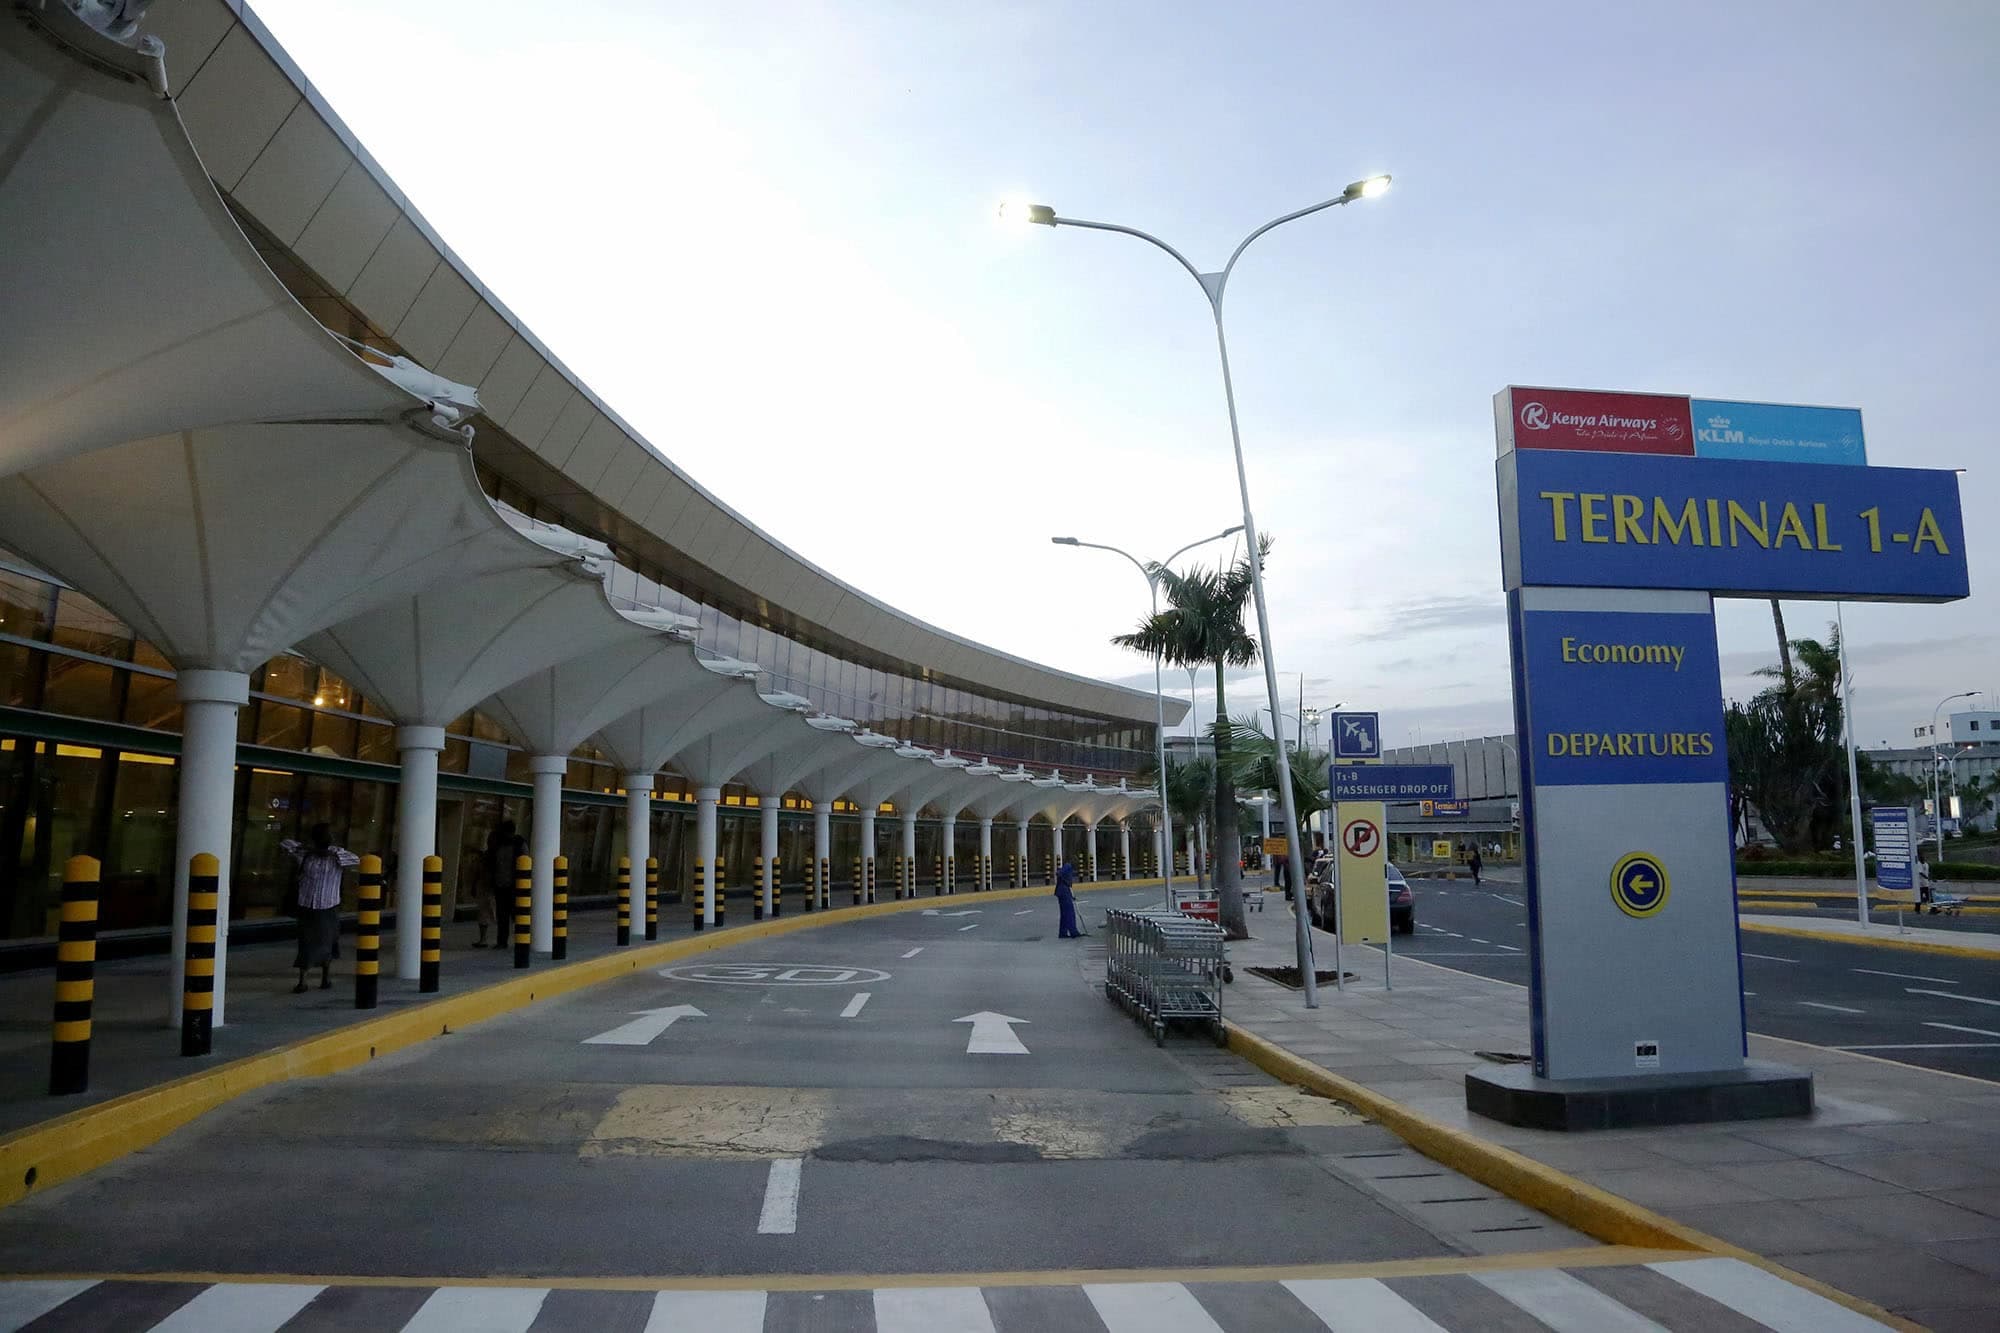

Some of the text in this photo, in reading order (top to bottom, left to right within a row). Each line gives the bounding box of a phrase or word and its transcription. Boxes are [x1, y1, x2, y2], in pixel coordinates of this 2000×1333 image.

[1552, 411, 1596, 428] Kenya
[1599, 414, 1657, 431] Airways
[1698, 429, 1744, 444] KLM
[1540, 491, 1950, 555] TERMINAL 1-A
[1561, 637, 1686, 672] Economy
[1547, 732, 1714, 756] DEPARTURES
[1336, 772, 1358, 781] T1-B
[1336, 784, 1449, 795] PASSENGER DROP OFF
[692, 966, 858, 982] 30
